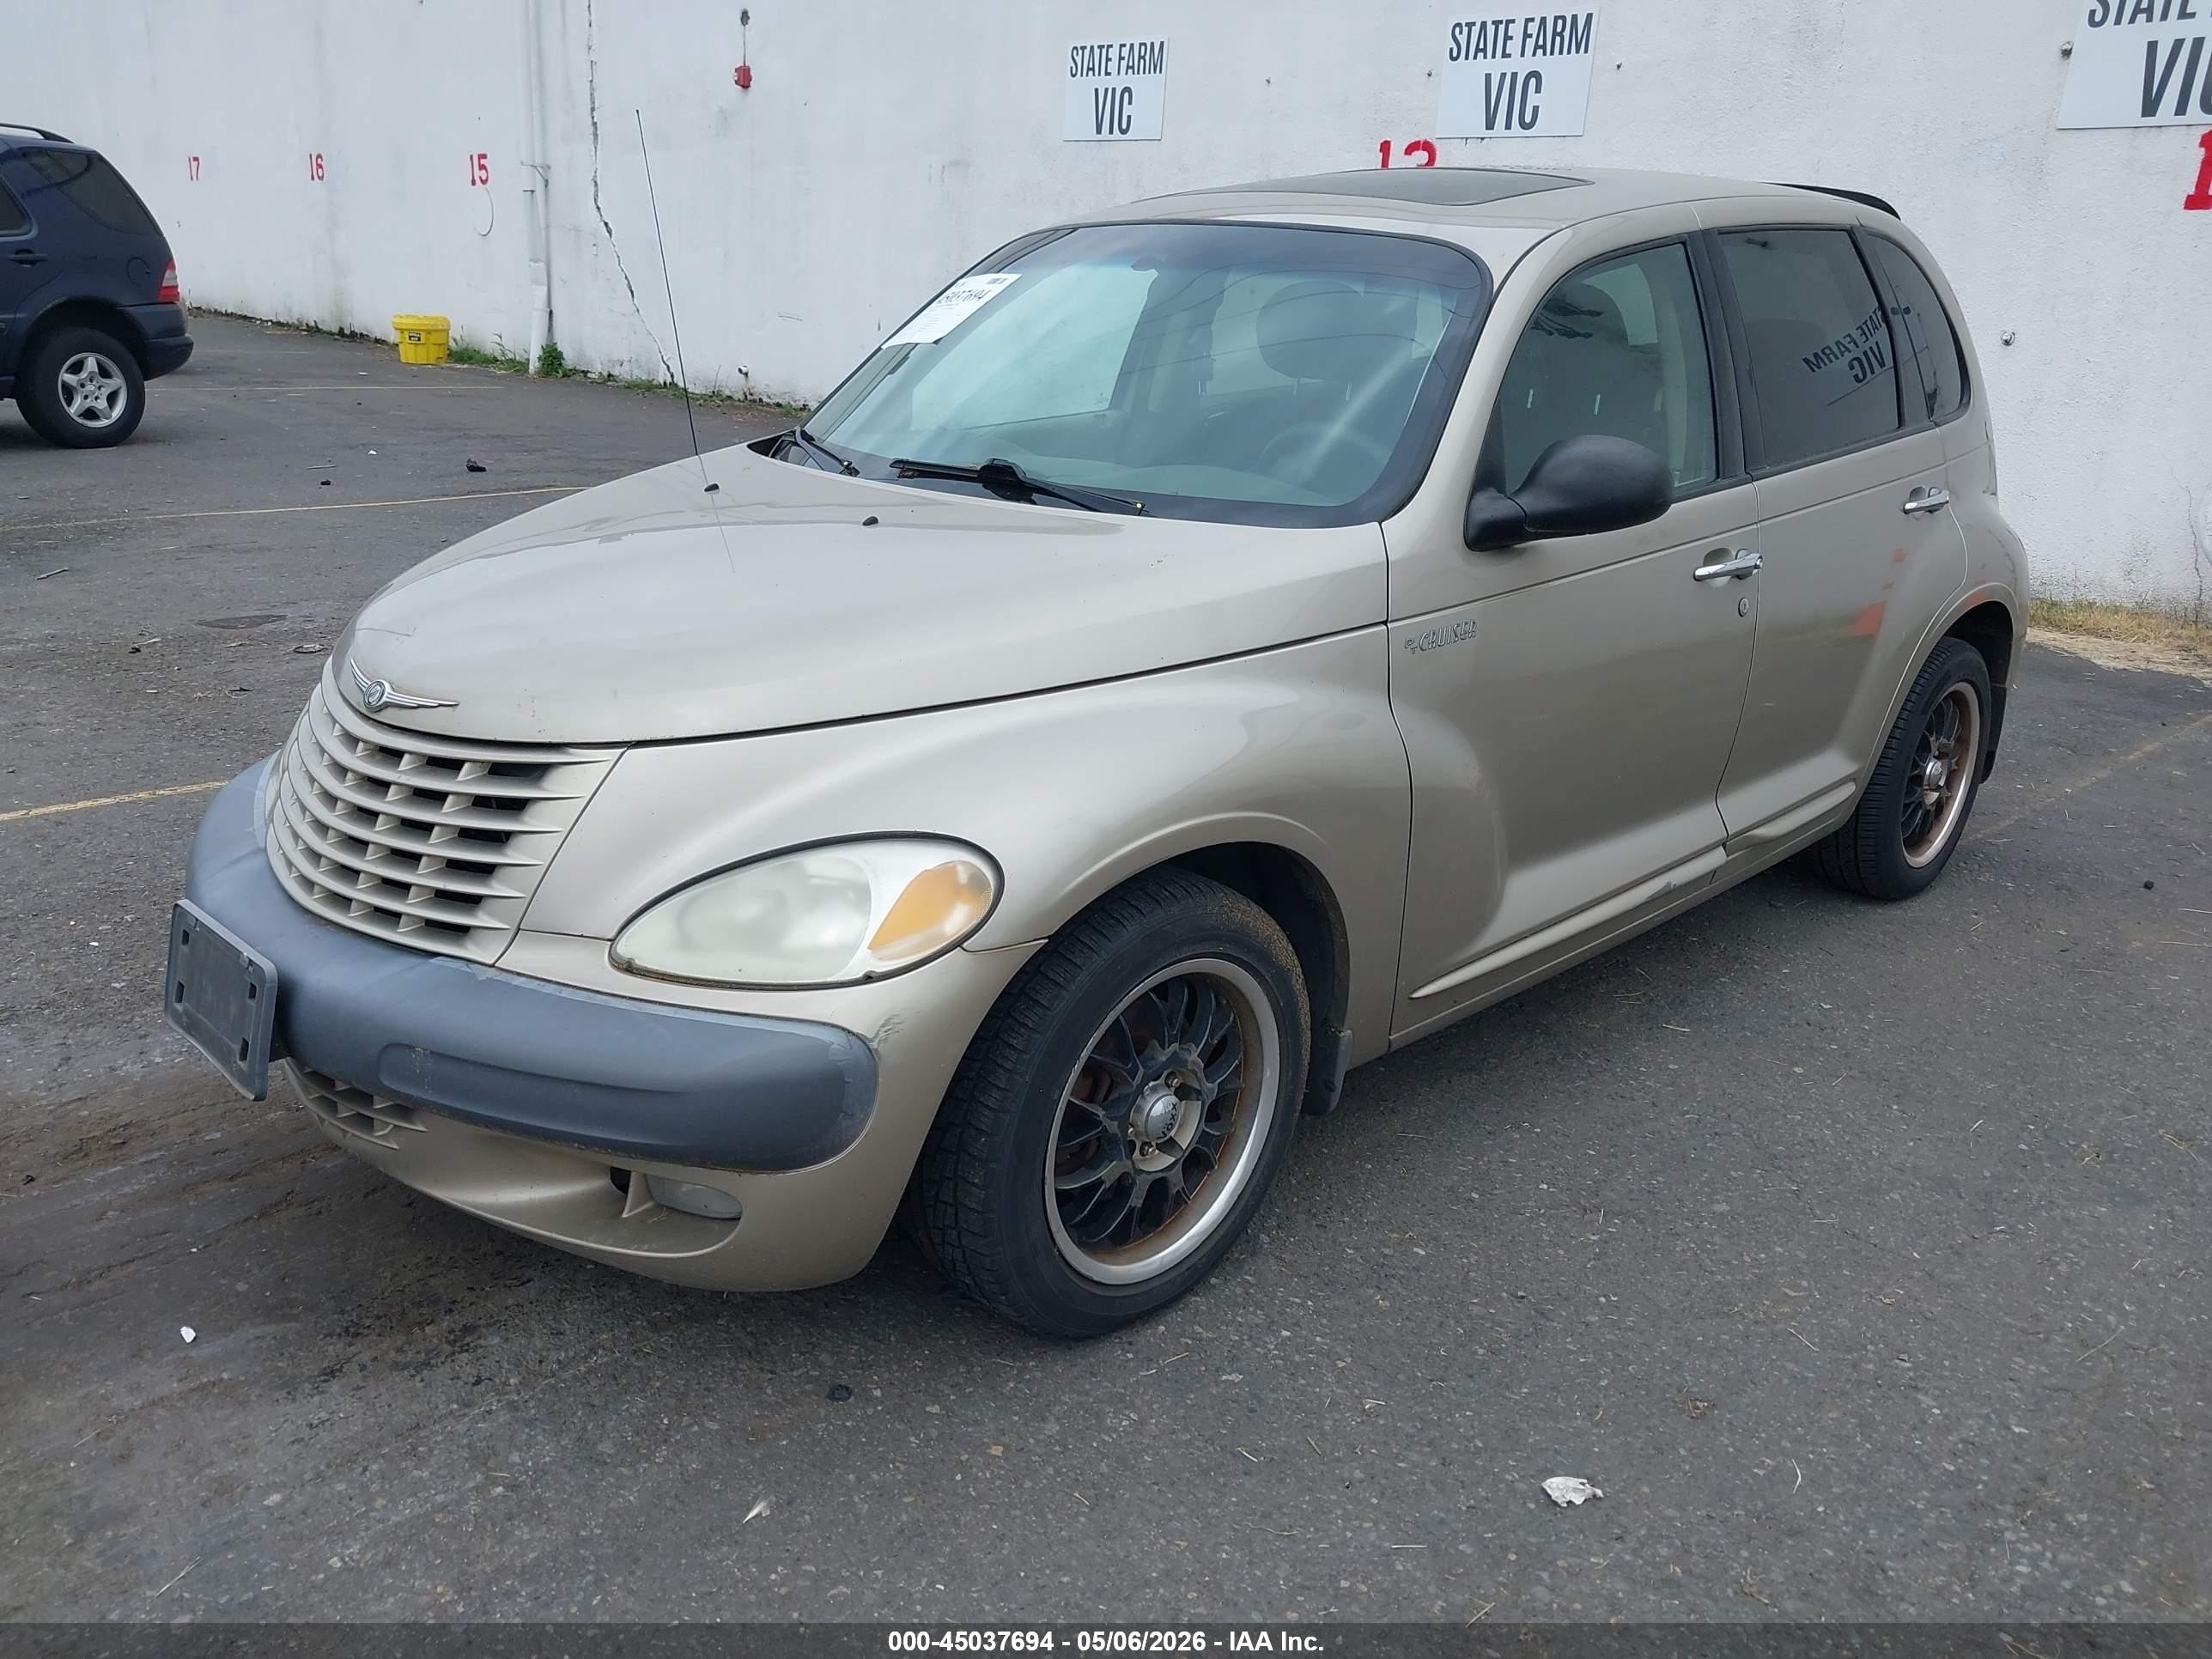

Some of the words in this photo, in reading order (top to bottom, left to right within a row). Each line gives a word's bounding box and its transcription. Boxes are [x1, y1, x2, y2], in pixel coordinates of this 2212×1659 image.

[1449, 19, 1516, 62] STATE
[1520, 12, 1594, 58] FARM
[1070, 44, 1114, 78] STATE
[1117, 41, 1164, 76] FARM
[2142, 36, 2212, 118] VI
[1094, 86, 1133, 135] VIC
[1485, 70, 1542, 131] VIC
[188, 156, 200, 181] 17
[309, 153, 325, 181] 16
[470, 154, 489, 186] 15
[1419, 619, 1476, 652] CRUISER
